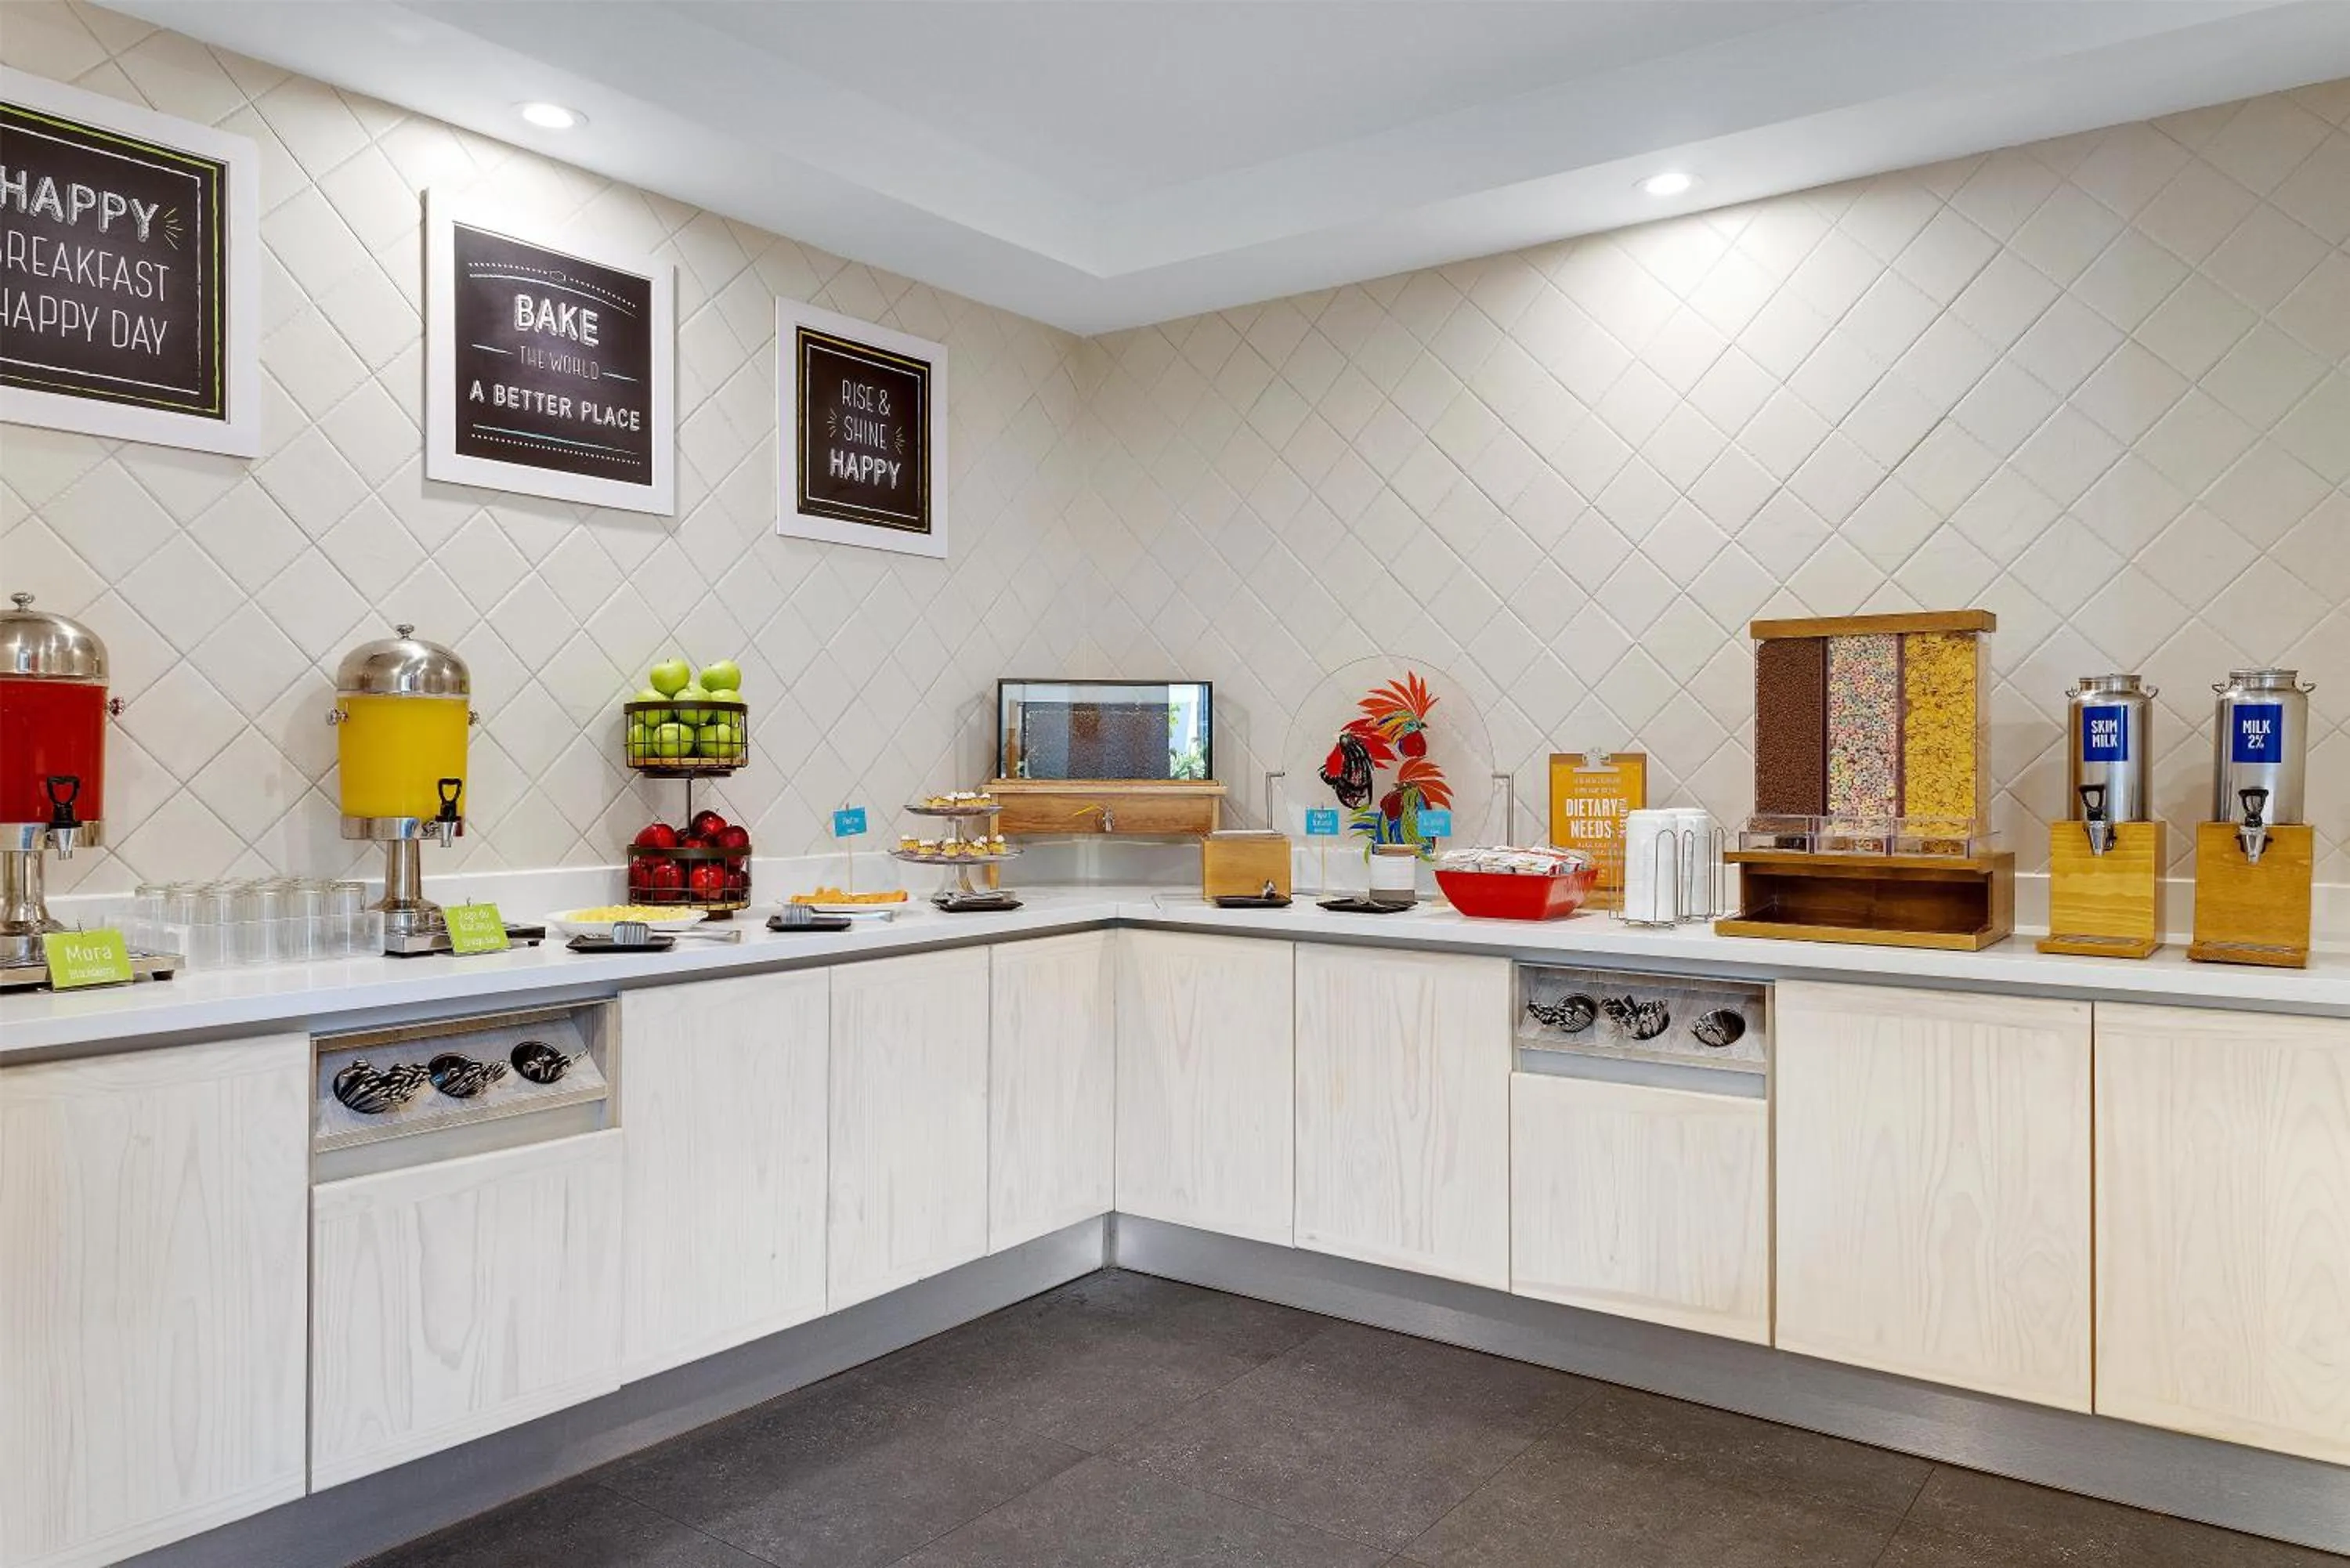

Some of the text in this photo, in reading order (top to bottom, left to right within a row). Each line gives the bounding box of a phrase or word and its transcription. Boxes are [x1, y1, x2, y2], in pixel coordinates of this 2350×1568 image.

[0, 165, 159, 243] HAPPY
[0, 230, 170, 302] REAKFAST
[111, 309, 168, 356] DAY
[514, 294, 599, 347] BAKE
[520, 345, 599, 380] THE WORLD
[470, 380, 641, 432] A BETTER PLACE
[842, 379, 891, 417] RISE &
[844, 415, 888, 450] SHINE
[829, 448, 902, 490] HAPPY
[2091, 718, 2117, 734] SKIM
[2092, 734, 2118, 748] MILK
[2243, 720, 2271, 734] MILK
[2247, 734, 2265, 750] 2%
[1566, 798, 1618, 817] DIETARY
[1570, 820, 1612, 839] NEEDS
[65, 945, 112, 963] Mora
